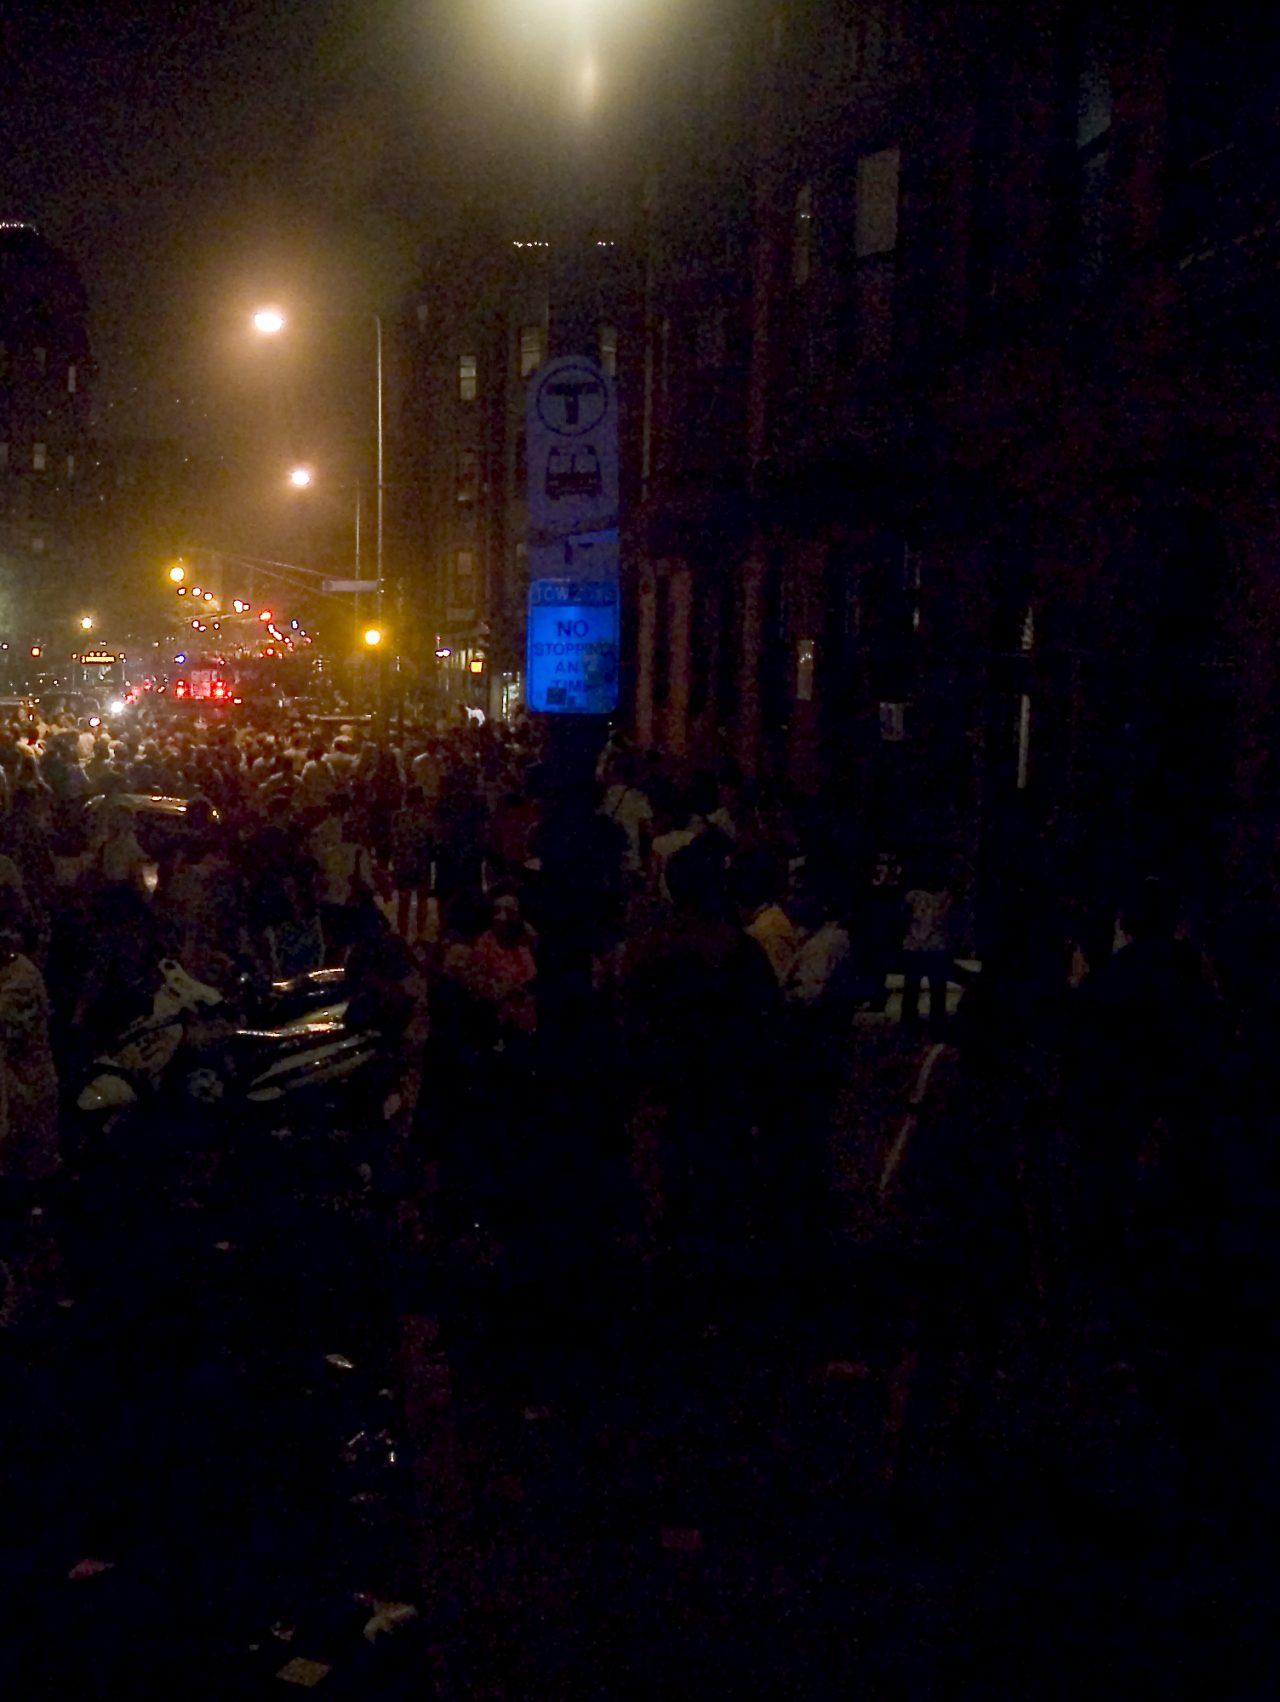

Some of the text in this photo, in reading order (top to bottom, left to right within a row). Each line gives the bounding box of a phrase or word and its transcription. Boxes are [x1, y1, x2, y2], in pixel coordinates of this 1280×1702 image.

[557, 619, 589, 637] NO
[533, 642, 614, 656] STOPPING
[555, 660, 591, 674] ANY
